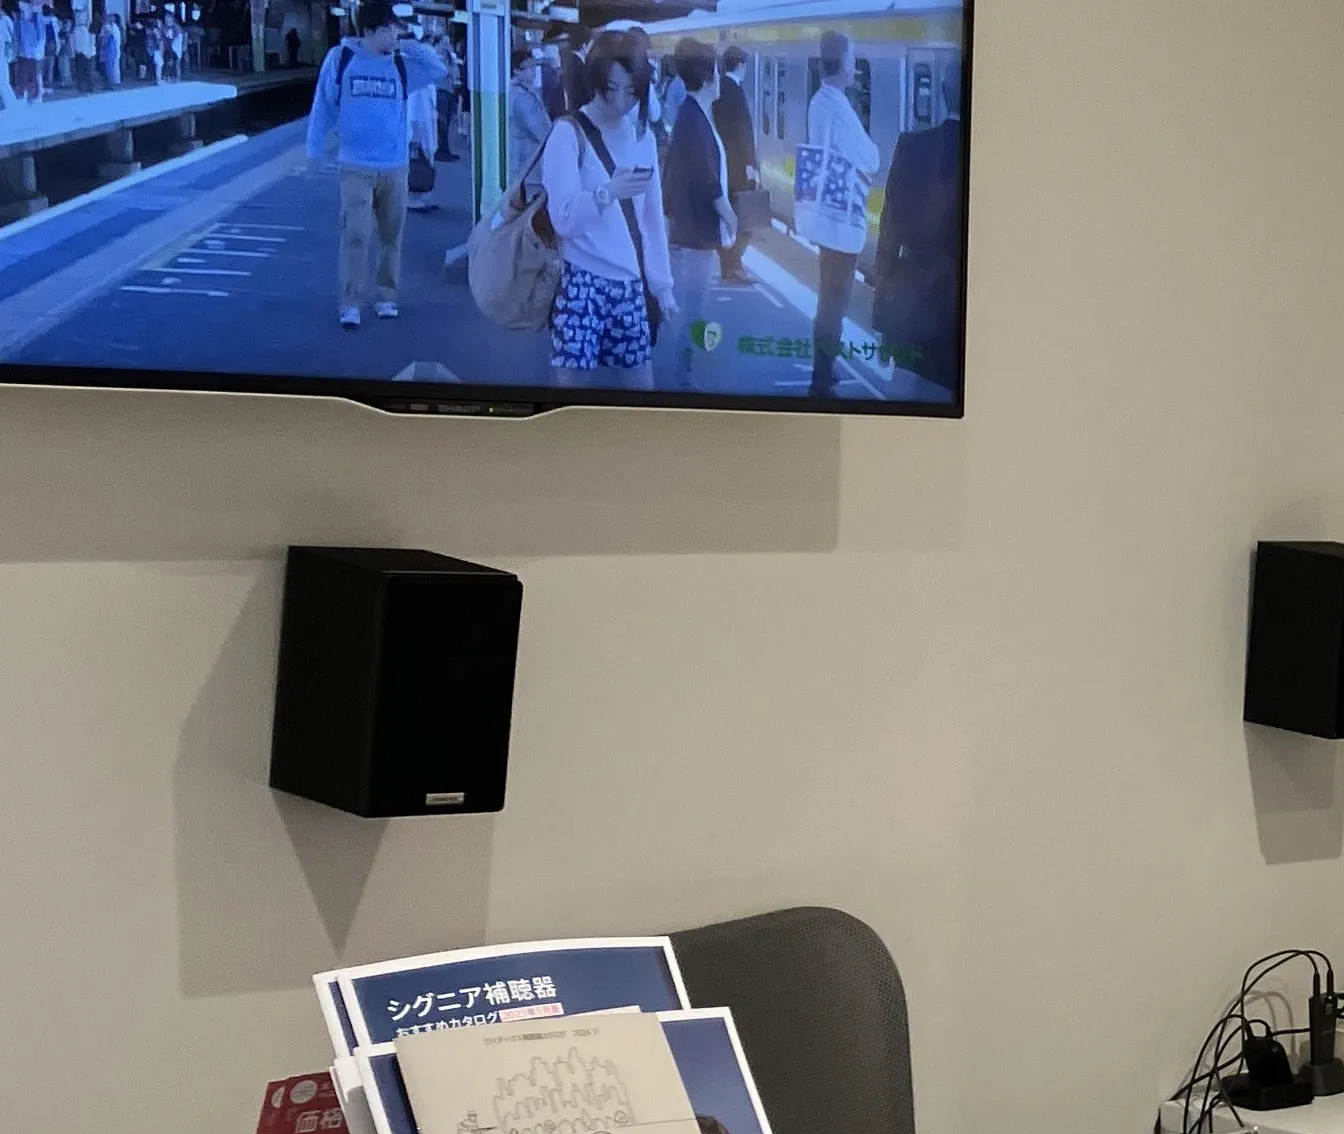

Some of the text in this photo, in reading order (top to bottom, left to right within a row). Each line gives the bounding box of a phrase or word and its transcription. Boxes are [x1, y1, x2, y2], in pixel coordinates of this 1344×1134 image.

[387, 975, 557, 1021] シグニア補聴器
